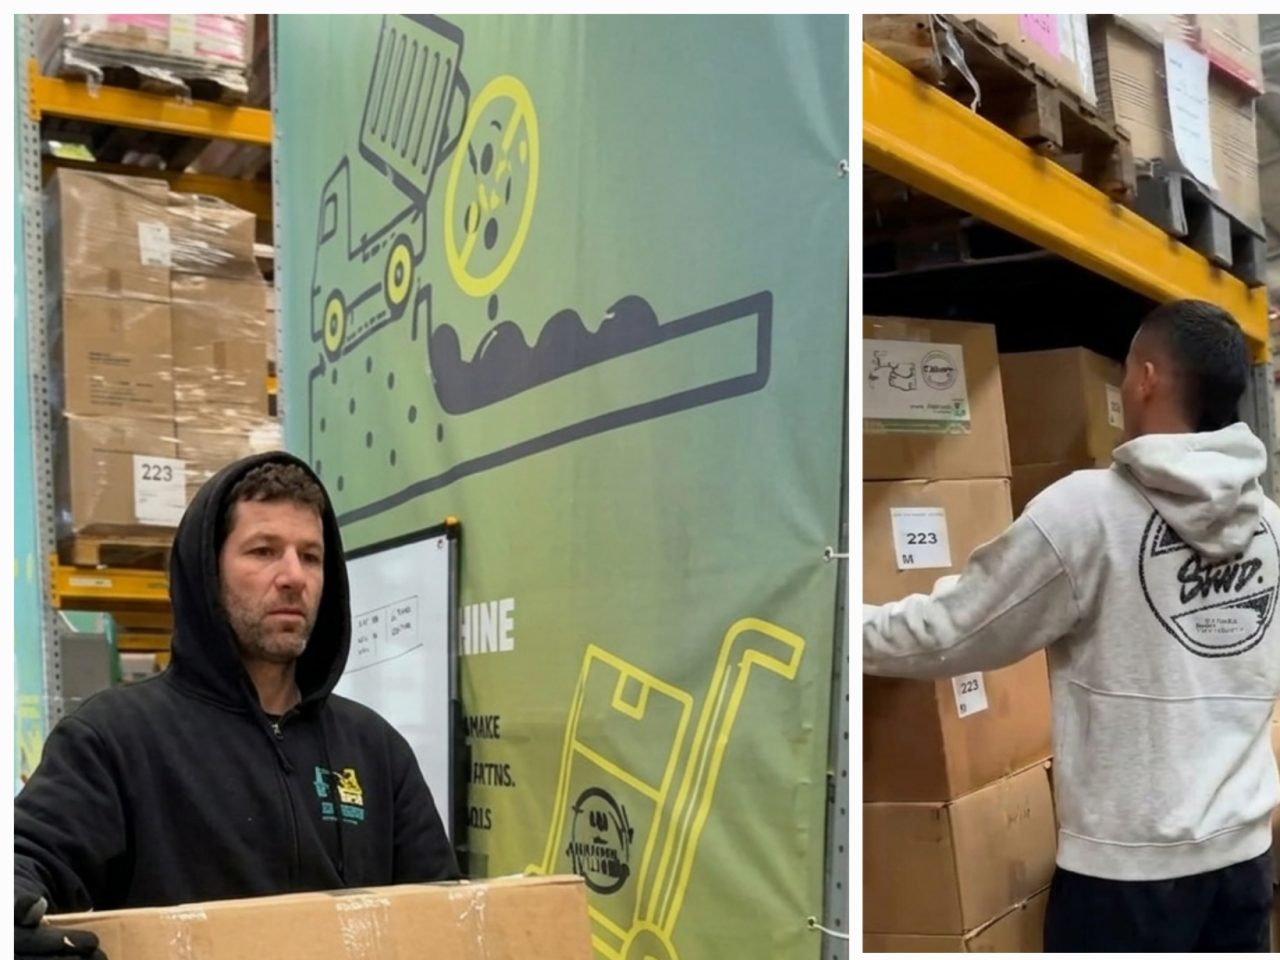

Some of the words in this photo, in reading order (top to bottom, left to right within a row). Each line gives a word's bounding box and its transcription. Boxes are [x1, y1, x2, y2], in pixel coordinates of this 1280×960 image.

[141, 463, 173, 482] 223
[906, 532, 938, 545] 223
[902, 554, 914, 564] M
[960, 679, 979, 694] 223
